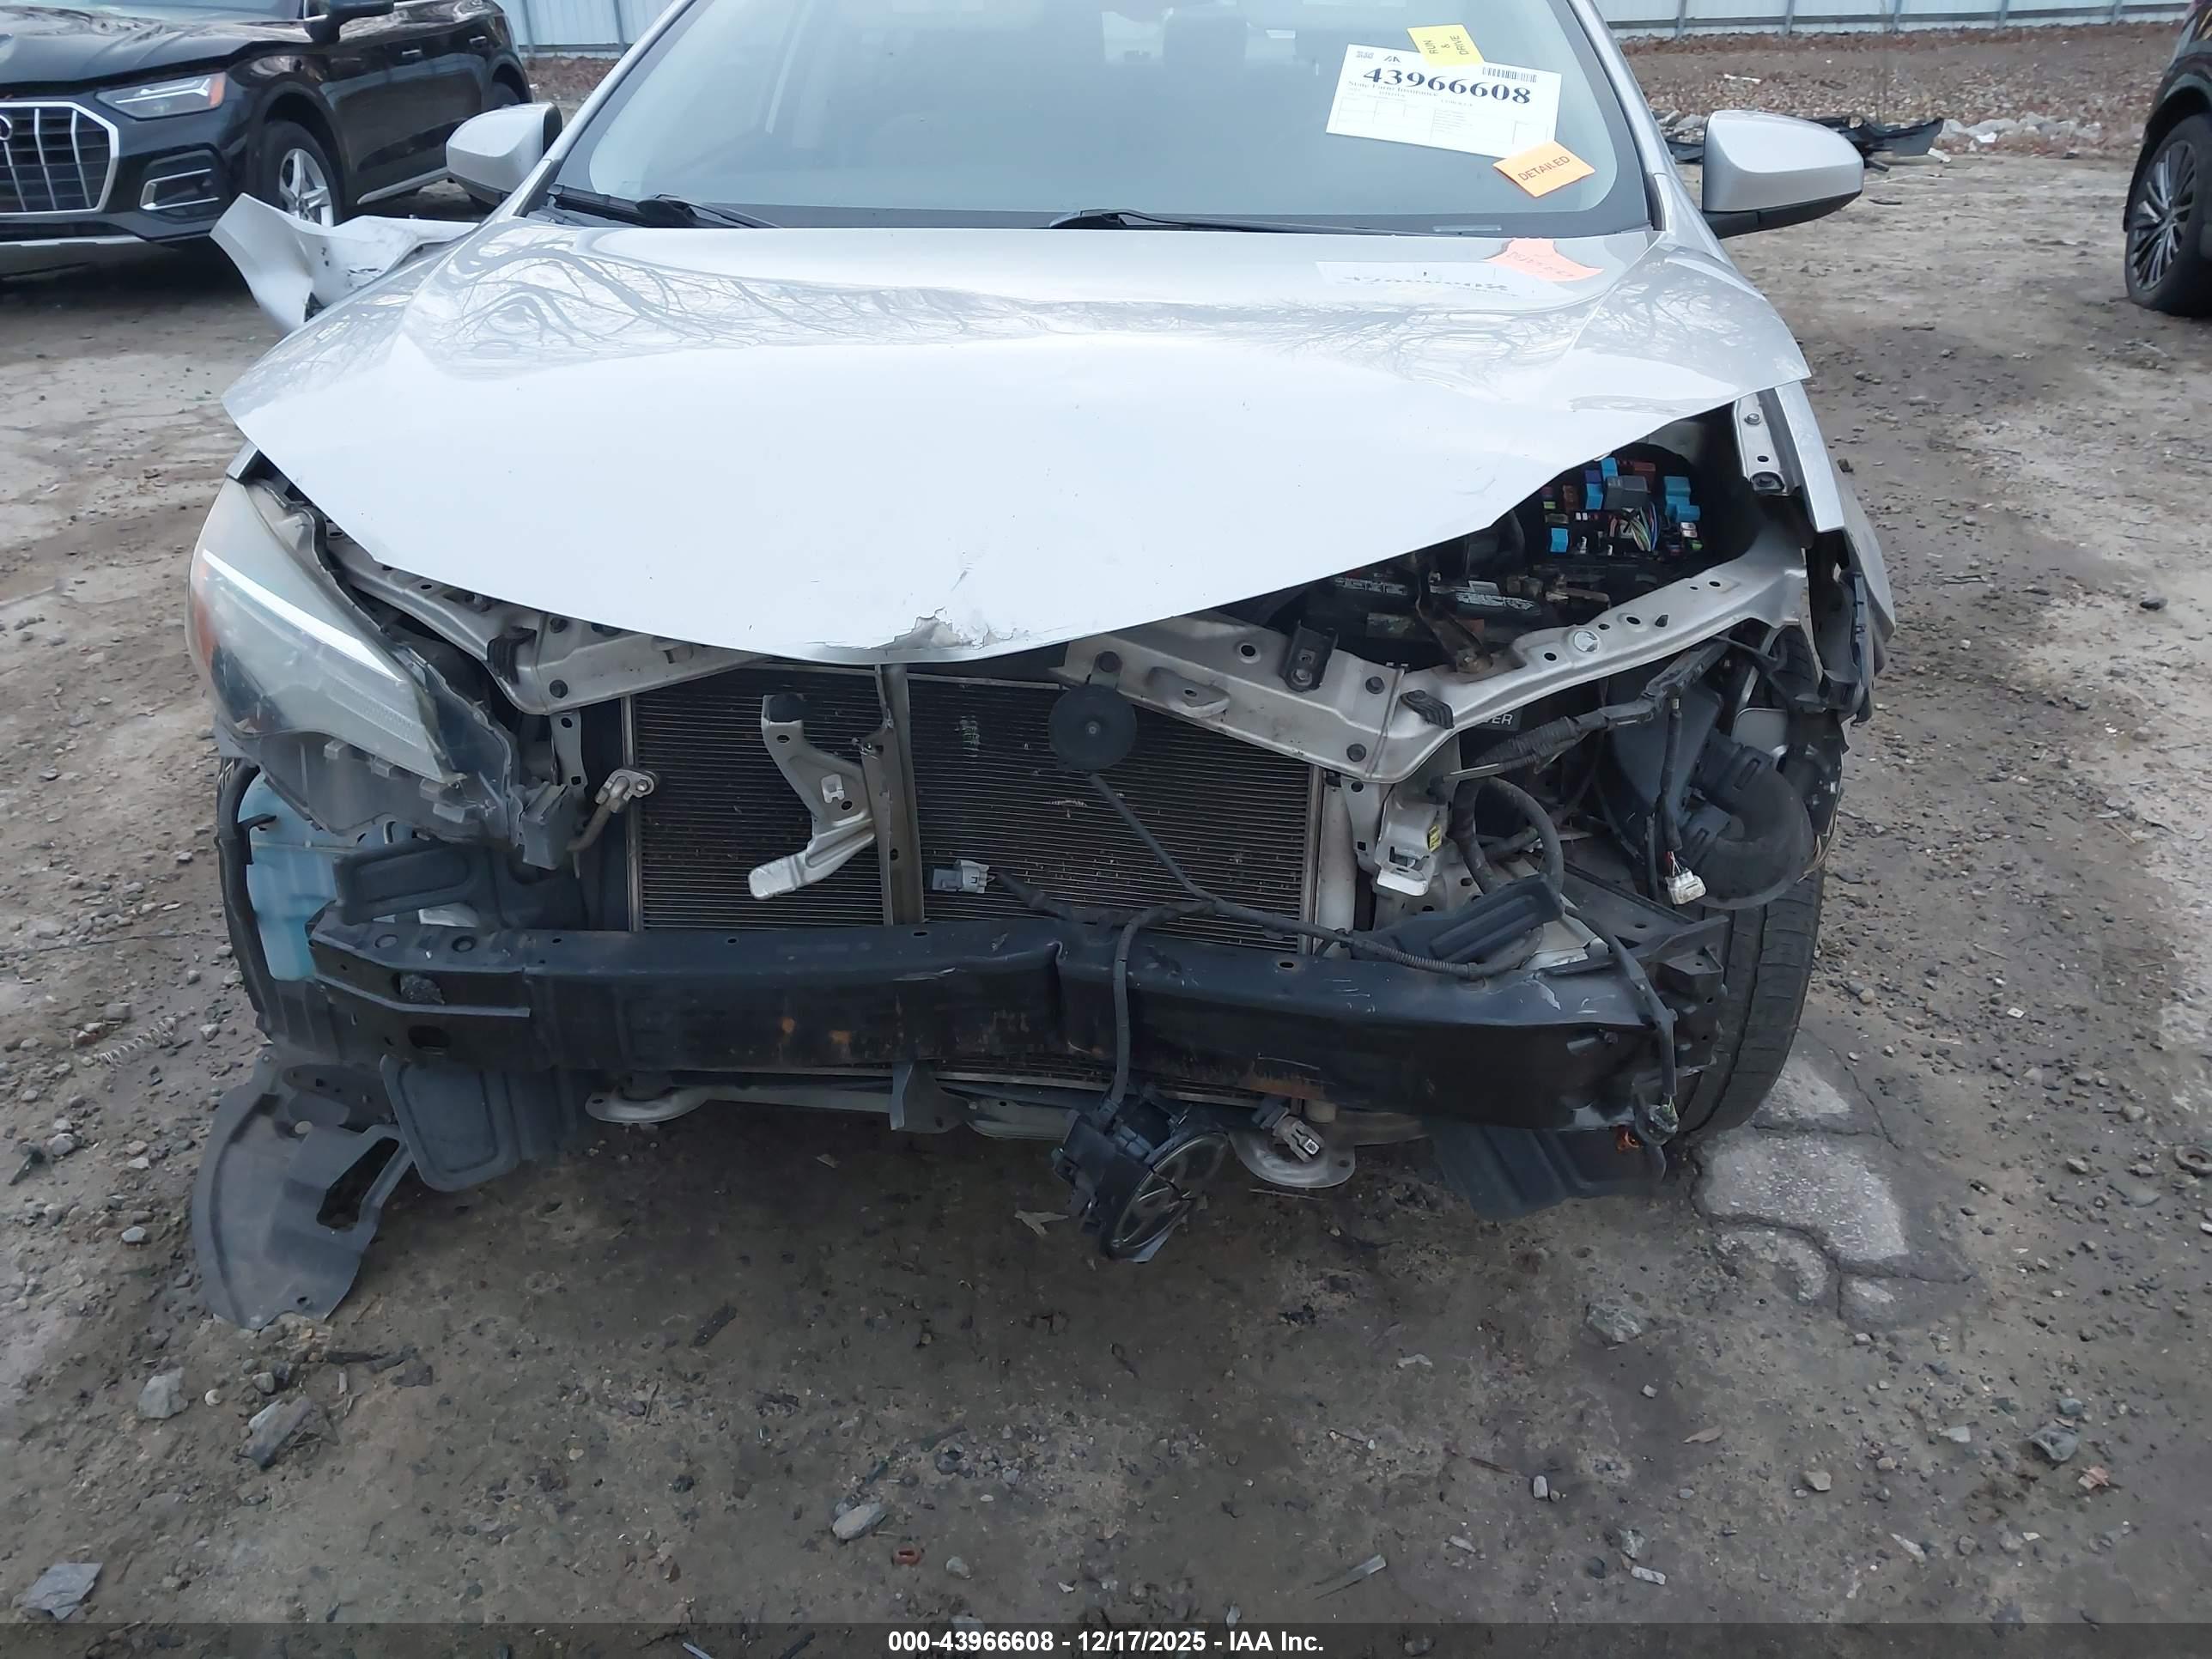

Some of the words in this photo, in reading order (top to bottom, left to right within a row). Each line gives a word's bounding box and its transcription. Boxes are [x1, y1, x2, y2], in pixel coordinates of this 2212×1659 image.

[1422, 40, 1439, 54] RUN
[1449, 34, 1470, 56] DRIVE
[1363, 67, 1531, 104] 43966608
[1517, 155, 1571, 181] DETAILED
